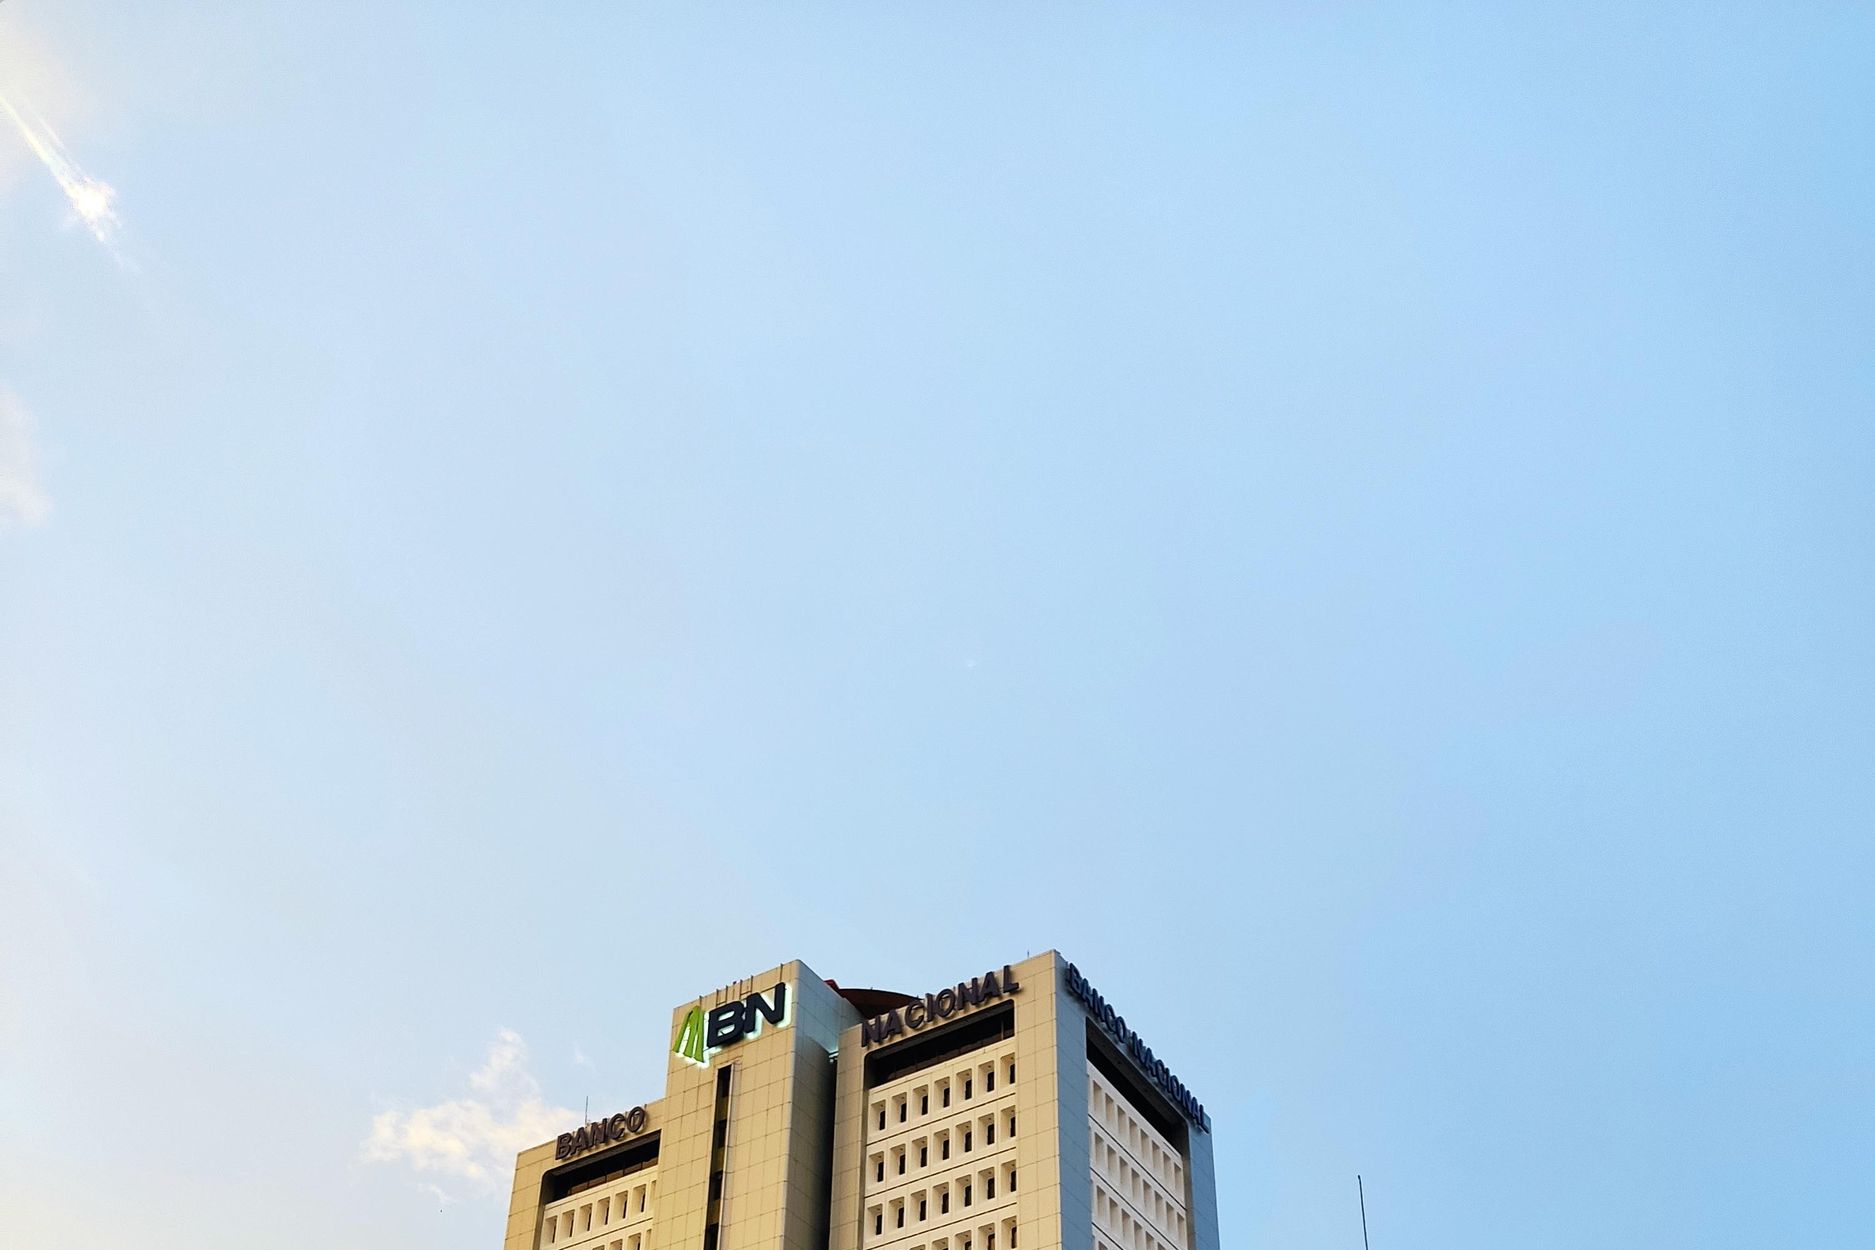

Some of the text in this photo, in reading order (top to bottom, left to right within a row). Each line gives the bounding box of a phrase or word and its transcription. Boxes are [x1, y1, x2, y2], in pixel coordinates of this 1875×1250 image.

[706, 981, 786, 1048] BN
[861, 965, 1019, 1047] NACIONAL
[1068, 962, 1210, 1134] BANCO NACIONAL
[554, 1106, 646, 1160] BANCO
